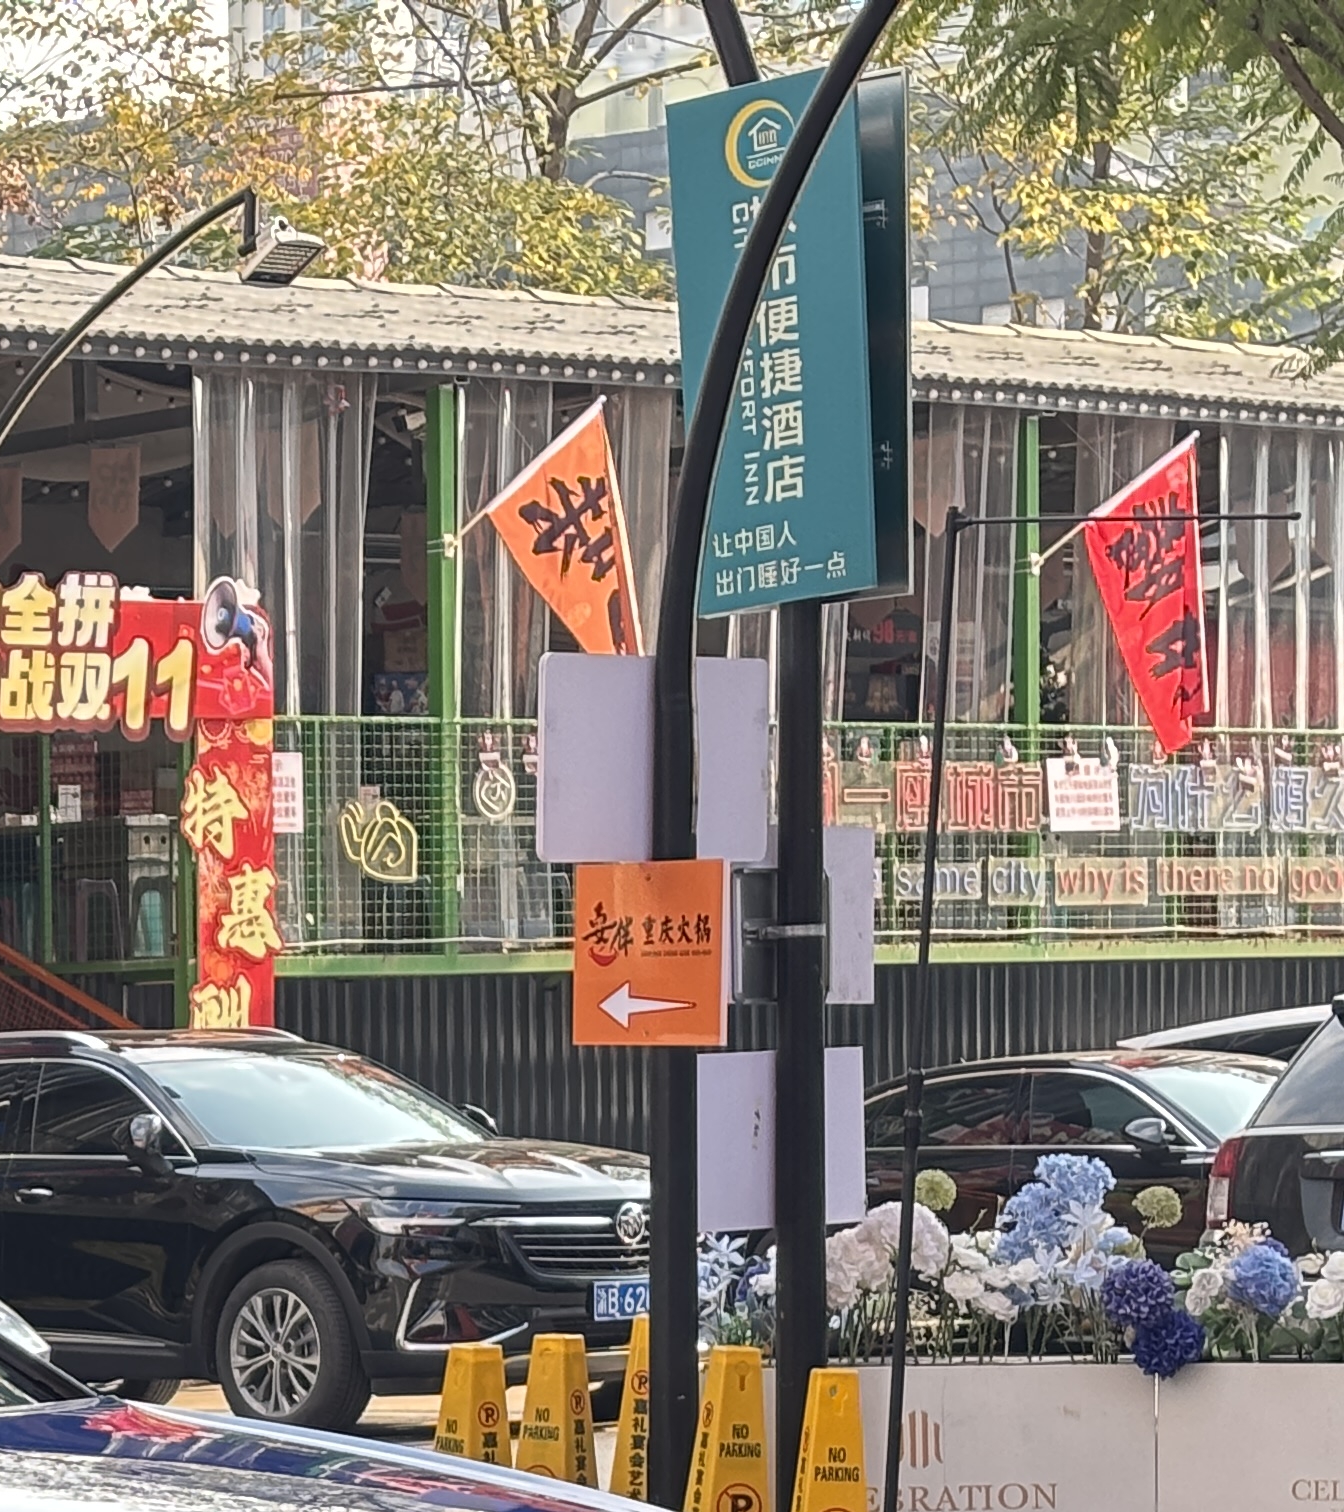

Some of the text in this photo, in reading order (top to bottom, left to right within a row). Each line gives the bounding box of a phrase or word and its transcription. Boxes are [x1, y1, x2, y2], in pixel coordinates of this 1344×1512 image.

[750, 196, 806, 504] 市便捷酒店
[740, 347, 757, 436] FORT
[743, 451, 761, 506] INN
[712, 520, 796, 558] 让中国人
[715, 551, 847, 597] 出门睡好一点
[992, 861, 1045, 900] city
[1059, 860, 1114, 901] why
[1122, 859, 1146, 893] is
[1161, 859, 1234, 893] there
[1244, 863, 1278, 893] no
[641, 912, 712, 945] 重庆火锅
[597, 1285, 650, 1316] 渝B·62
[445, 1418, 458, 1435] NO
[534, 1407, 550, 1423] NO
[435, 1435, 465, 1454] PARKING
[522, 1423, 560, 1442] PARKING
[731, 1423, 750, 1440] NO
[718, 1442, 762, 1458] PARKING
[827, 1446, 847, 1464] NO
[814, 1466, 860, 1483] PARKING
[867, 1482, 1058, 1512] ERATION
